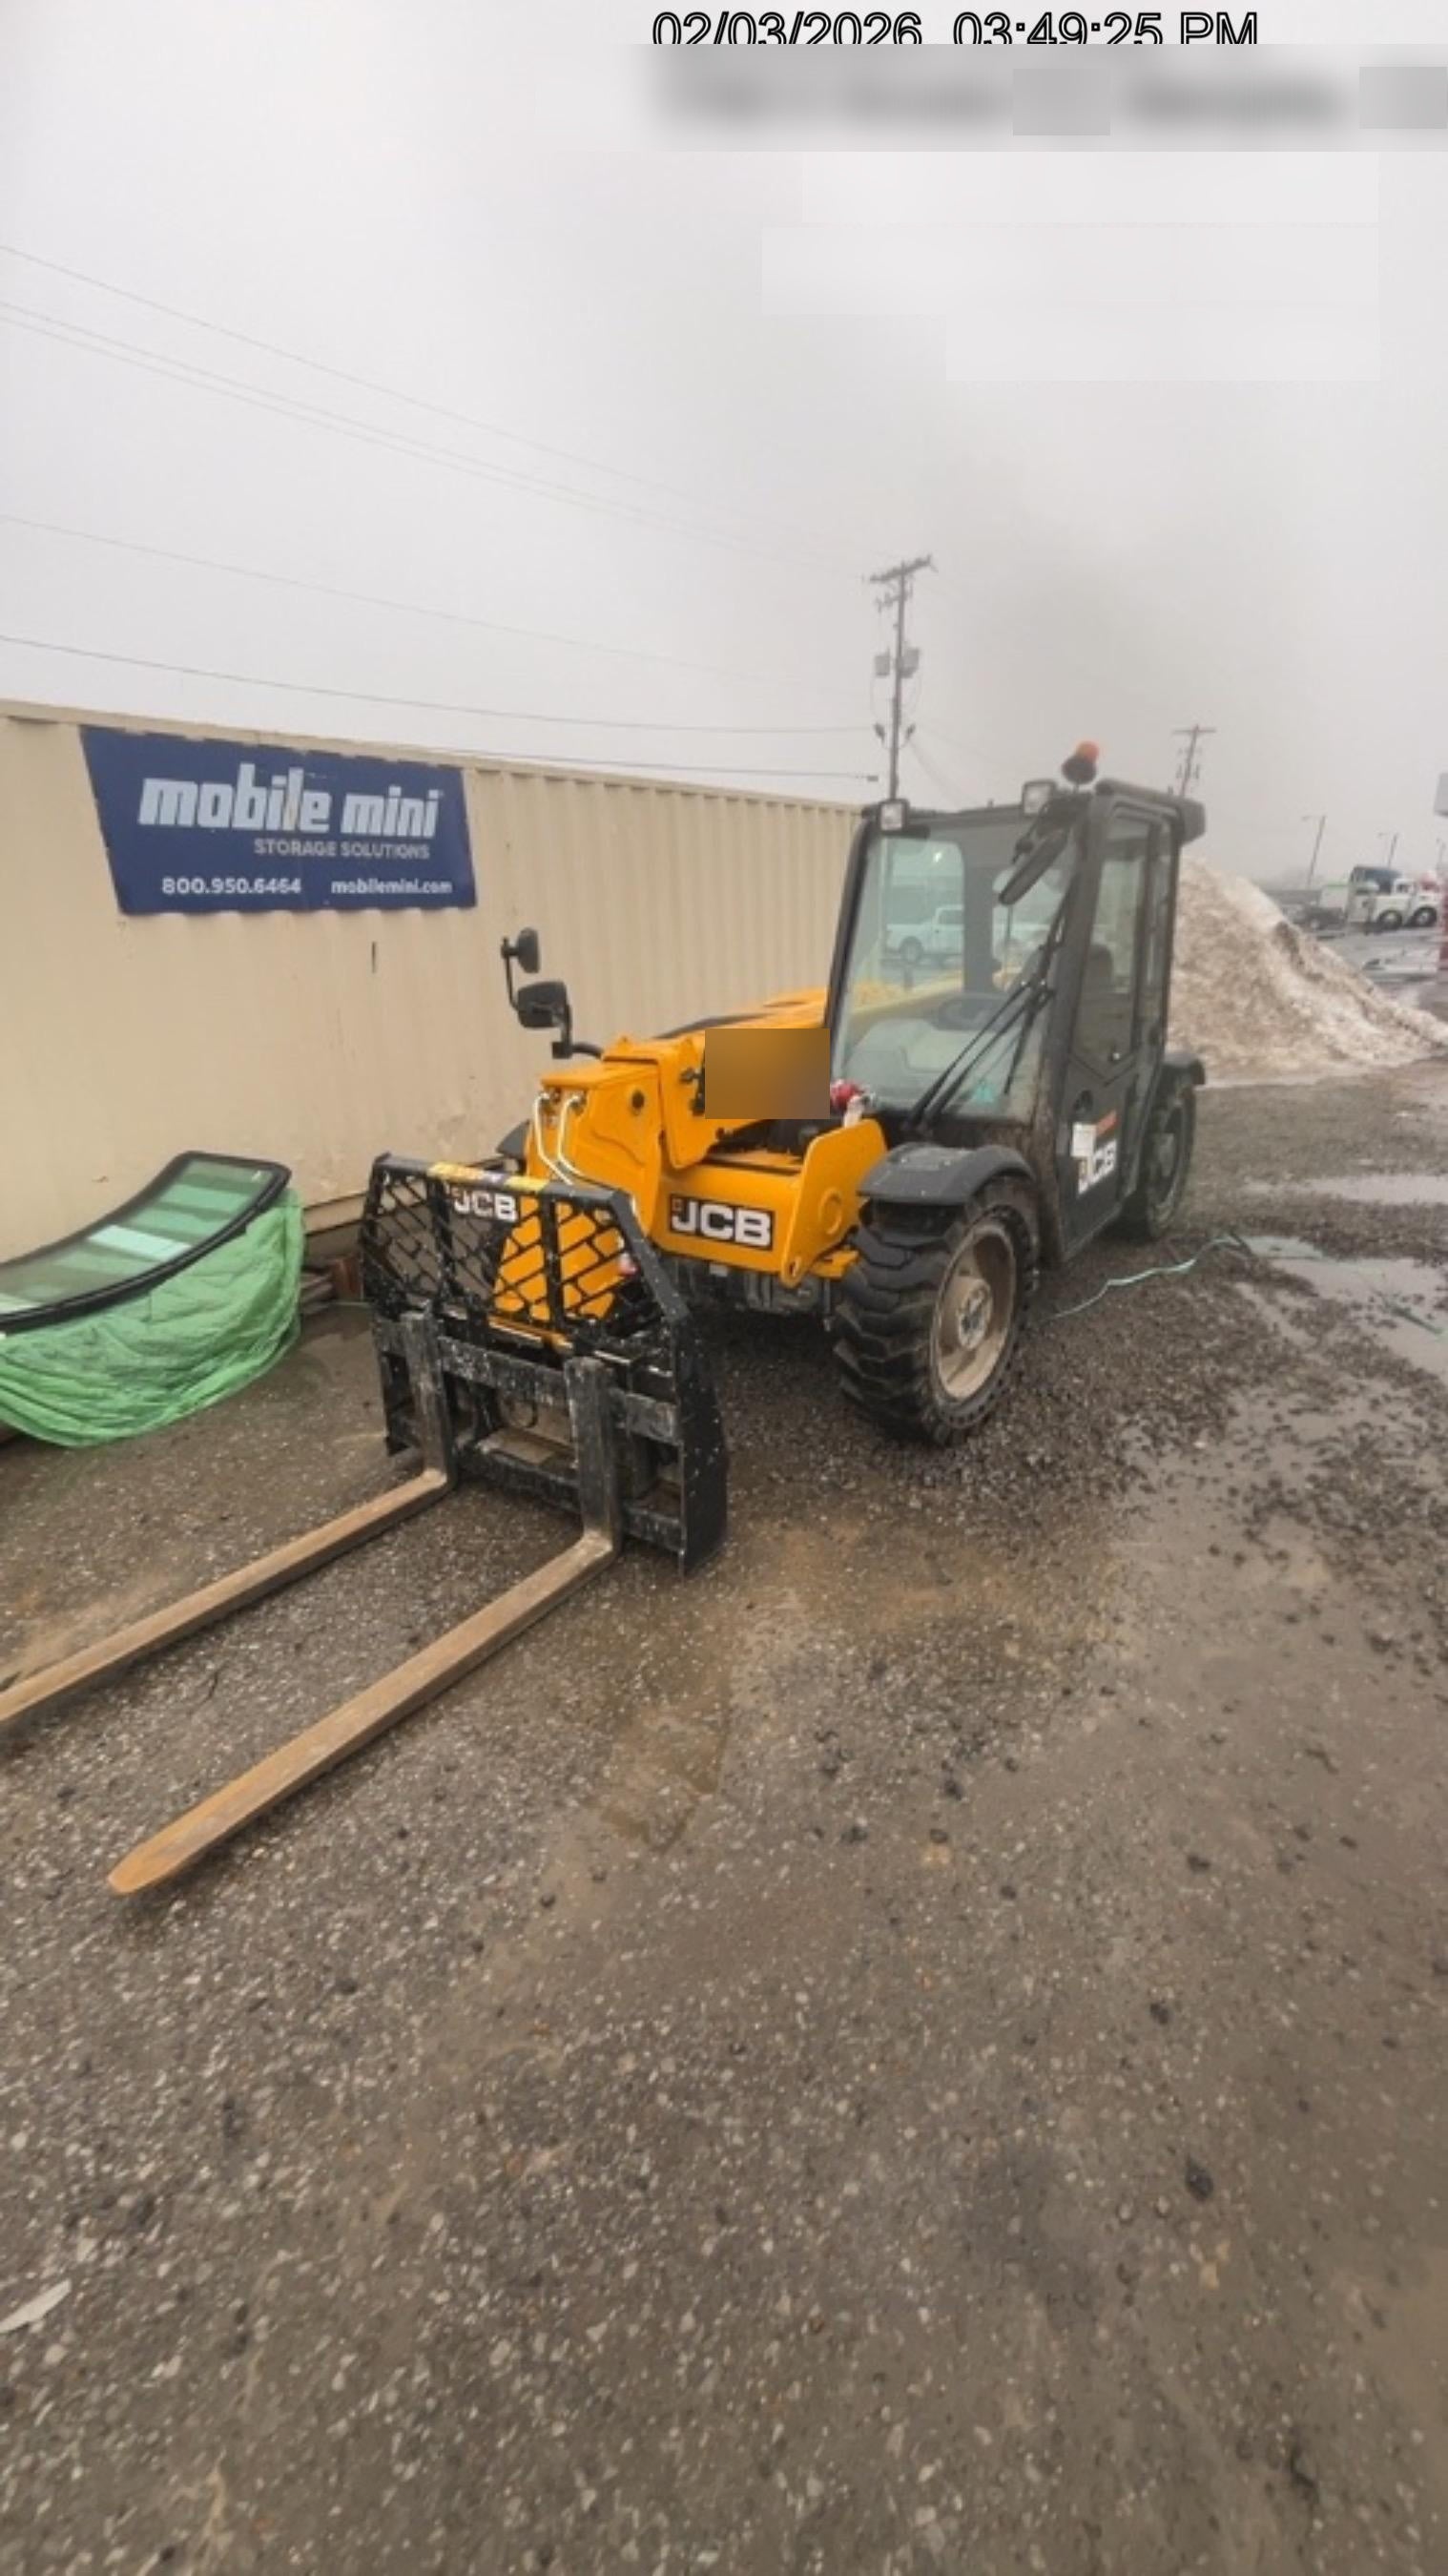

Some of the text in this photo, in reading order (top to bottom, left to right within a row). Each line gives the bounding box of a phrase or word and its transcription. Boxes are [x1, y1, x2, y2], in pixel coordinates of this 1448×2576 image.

[137, 762, 441, 838] mobile mini
[254, 838, 430, 860] STORAGE SOLUTIONS
[331, 878, 453, 895] mobilemini.com
[454, 1190, 518, 1221] JCB
[671, 1200, 771, 1247] JCB
